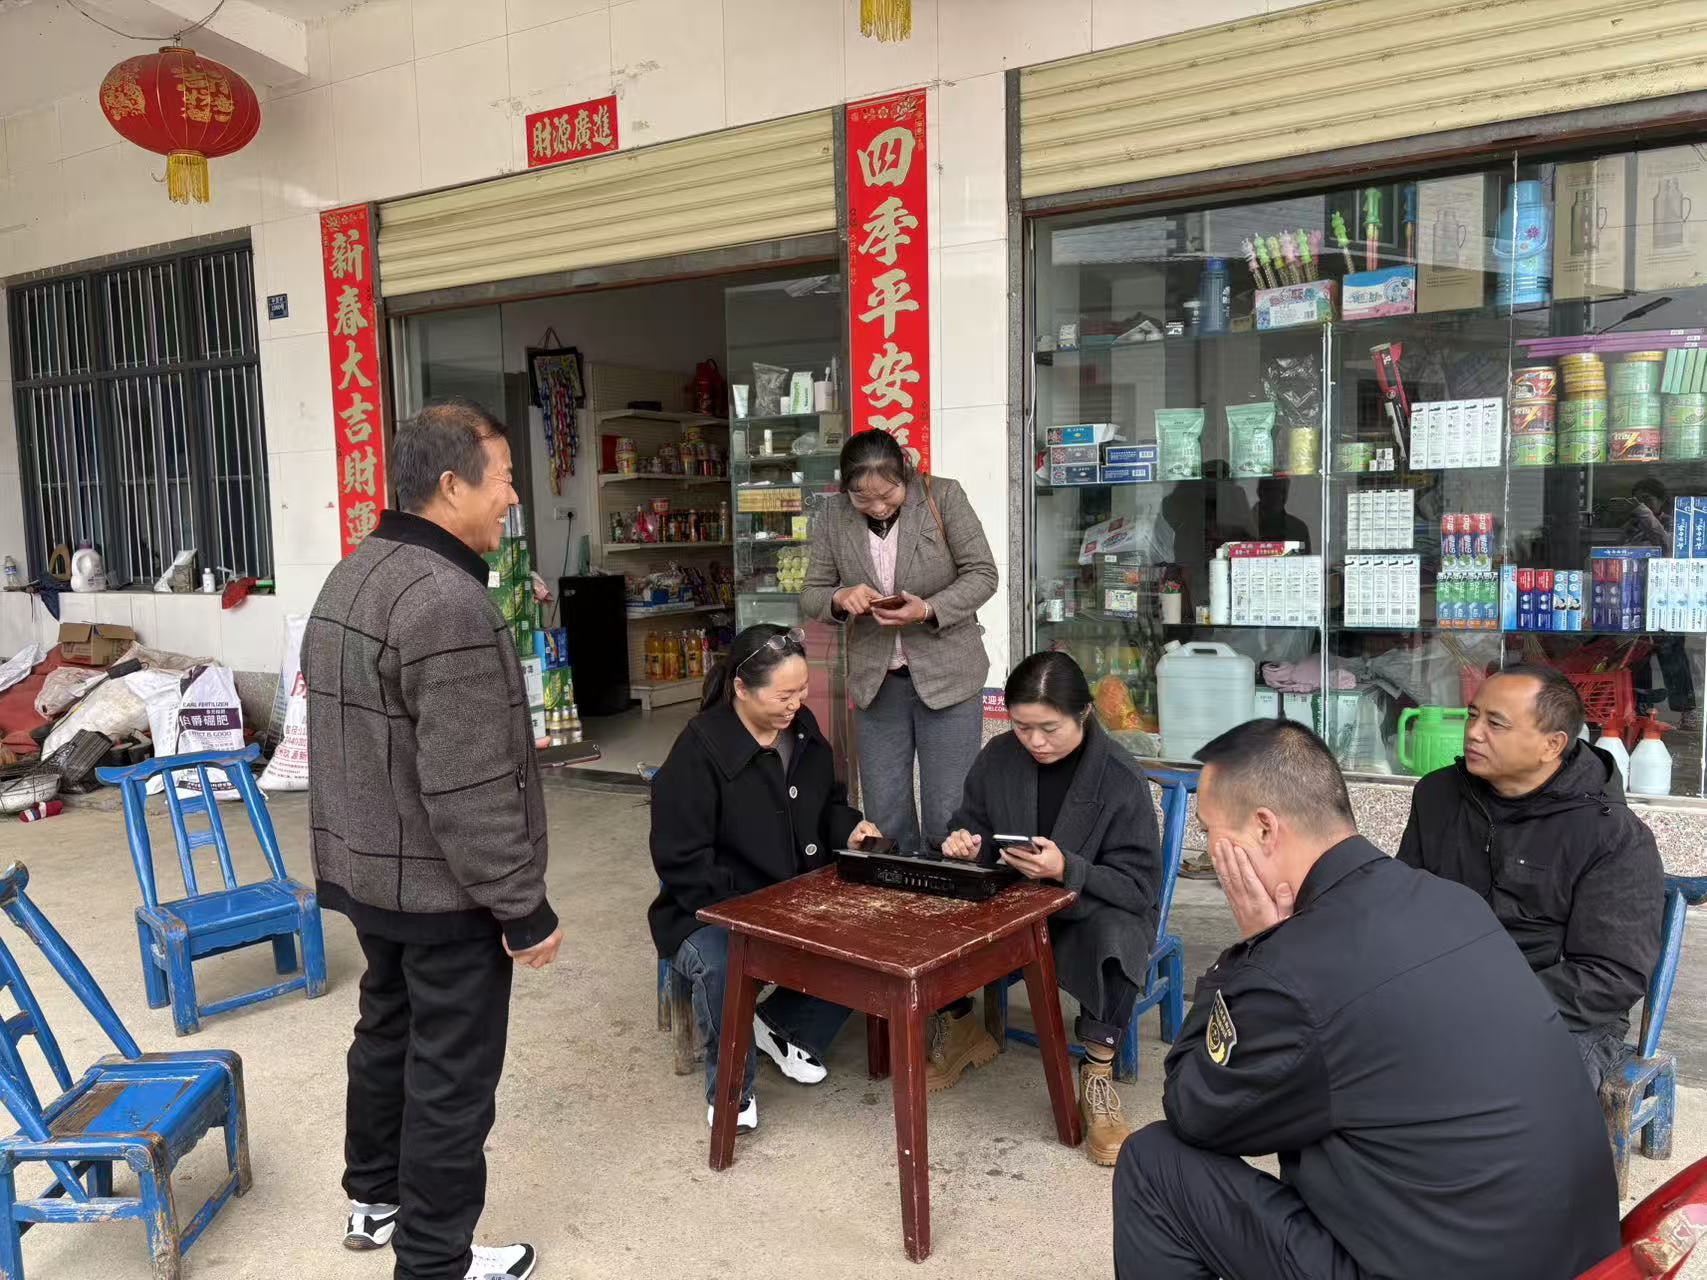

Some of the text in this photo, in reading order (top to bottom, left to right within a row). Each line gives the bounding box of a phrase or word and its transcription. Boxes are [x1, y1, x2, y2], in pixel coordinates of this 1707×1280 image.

[533, 104, 613, 158] 財源廣進
[329, 229, 377, 545] 新春大吉財運
